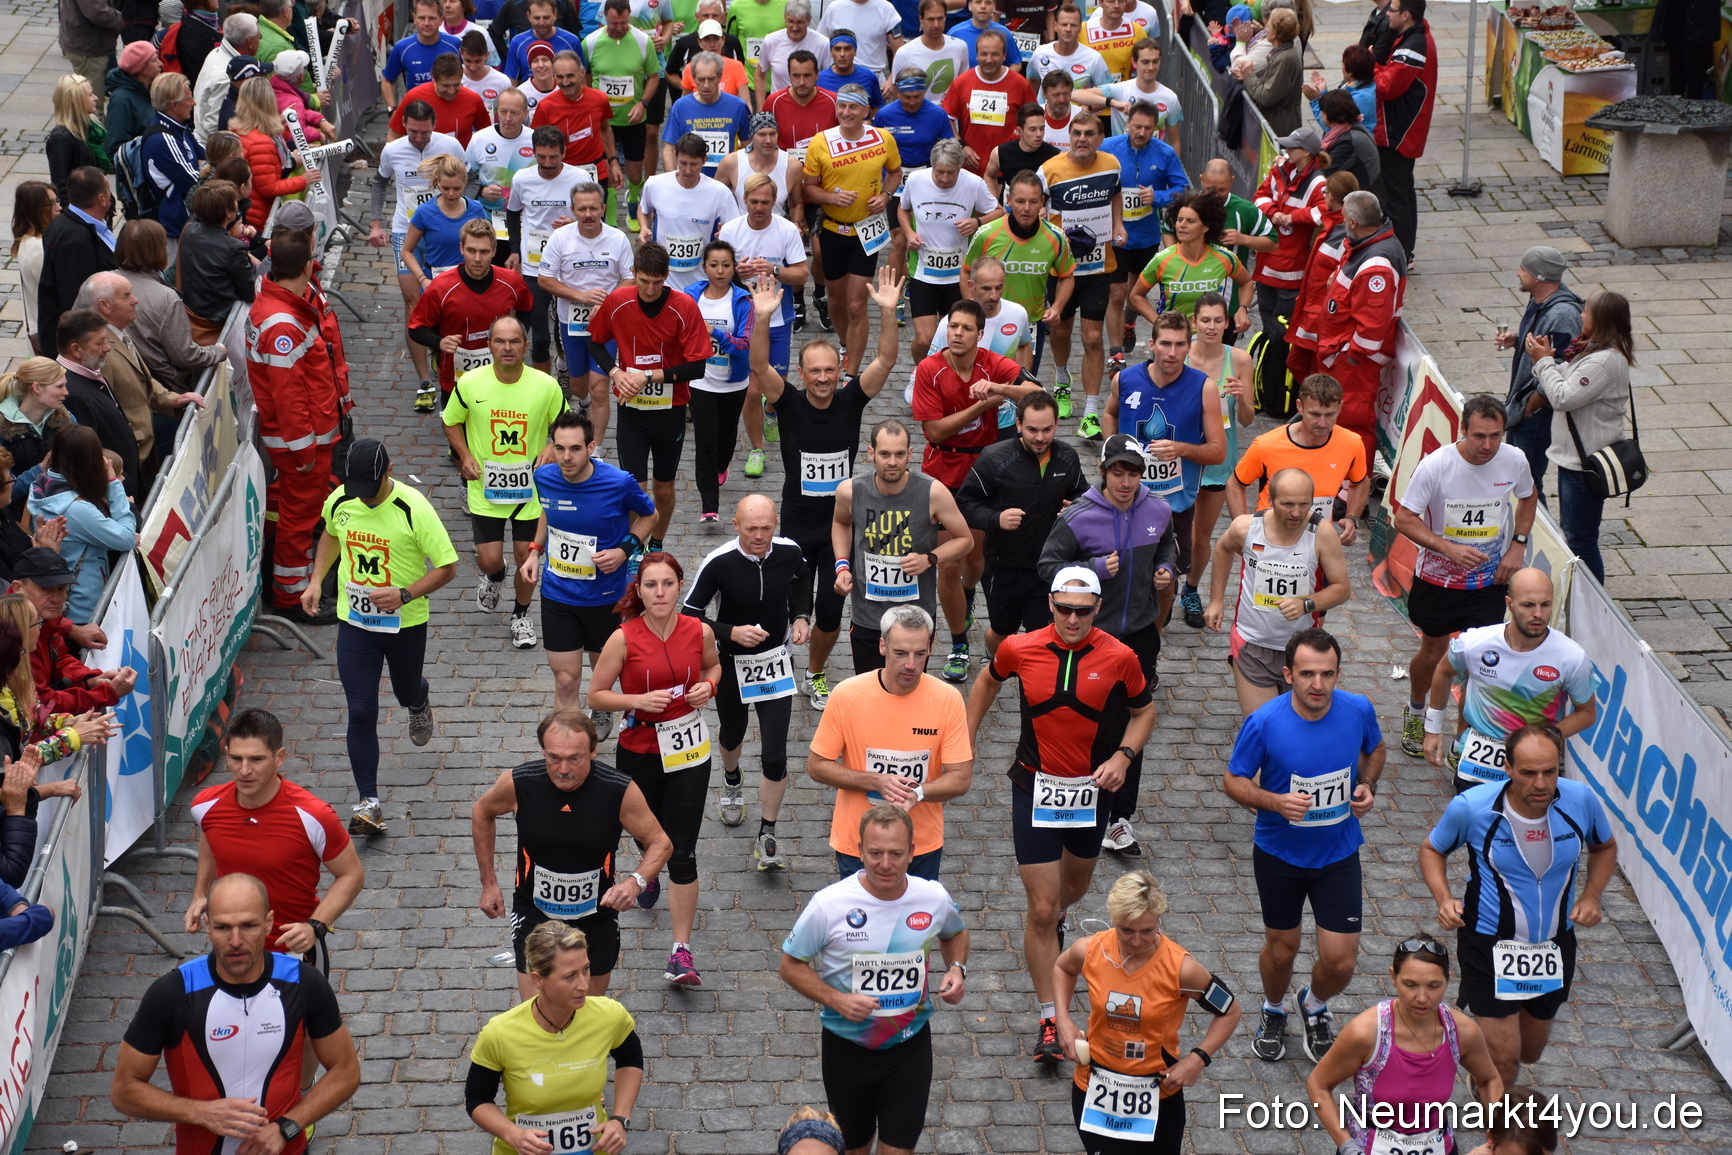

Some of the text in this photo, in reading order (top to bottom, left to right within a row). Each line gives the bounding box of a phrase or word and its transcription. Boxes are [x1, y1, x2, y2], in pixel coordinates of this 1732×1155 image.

[606, 84, 627, 96] 257
[981, 99, 996, 112] 24
[293, 127, 309, 152] BMW
[705, 140, 725, 154] 512
[831, 147, 887, 169] MAX BÖGL
[1072, 188, 1110, 202] Fischer
[1076, 196, 1109, 206] AUTOMOBILE
[1125, 196, 1145, 209] 30
[669, 243, 701, 258] 2397
[678, 261, 692, 269] Peter
[927, 255, 959, 269] 3043
[1002, 260, 1048, 275] OCK
[1168, 278, 1219, 294] BOCK
[639, 383, 664, 397] 89
[637, 398, 659, 406] Markus
[1124, 391, 1142, 410] 4
[490, 409, 528, 420] Müller
[500, 430, 519, 446] M
[485, 464, 500, 472] PARTL
[806, 462, 845, 480] 3111
[488, 471, 529, 488] 2390
[1148, 482, 1170, 492] Martin
[493, 489, 524, 499] Wolfgang
[864, 508, 911, 535] RUN
[1461, 510, 1485, 526] 44
[346, 529, 390, 547] Müller
[1456, 529, 1488, 538] Matthias
[564, 535, 587, 546] Neumarkt
[864, 532, 913, 557] THIS
[560, 542, 580, 562] 87
[357, 554, 380, 576] M
[865, 556, 882, 565] PARTL
[556, 562, 582, 574] Michael
[1257, 567, 1302, 578] PARTL Neumarkt
[874, 587, 909, 597] Alexander
[1265, 577, 1298, 597] 161
[363, 617, 382, 625] Mike
[755, 653, 780, 664] Neumarkt
[742, 658, 786, 684] 2241
[1480, 667, 1498, 676] PARTL
[760, 684, 777, 694] Rudi
[658, 724, 679, 734] PARTL
[912, 727, 939, 736] THULE
[671, 722, 702, 751] 317
[1471, 730, 1489, 742] PARTL
[685, 751, 700, 761] Eva
[868, 753, 920, 763] PARTL Neumarkt
[1467, 740, 1507, 768] 226
[873, 762, 924, 784] 2529
[1472, 767, 1505, 782] Richard
[1292, 776, 1343, 789] PARTL Neumarkt
[1040, 787, 1094, 808] 2570
[1054, 811, 1075, 821] Sven
[1309, 809, 1337, 821] Stefan
[536, 870, 590, 885] PARTL Neumarkt
[539, 880, 594, 903] 3093
[539, 900, 582, 913] Michael
[910, 915, 931, 926] Hervis
[846, 931, 869, 939] PARTL
[1494, 942, 1550, 952] PARTL Neumarkt
[881, 958, 914, 967] Neumarkt
[1501, 953, 1558, 977] 2626
[860, 967, 920, 993] 2629
[1516, 982, 1543, 993] Oliver
[879, 996, 905, 1009] atrick
[212, 1026, 231, 1037] tkn
[1113, 1078, 1148, 1090] Neumarkt
[1093, 1083, 1153, 1115] 2198
[518, 1114, 584, 1127] PARTL Neumarkt
[1105, 1116, 1133, 1130] Maria
[1402, 1137, 1436, 1147] Neumarkt
